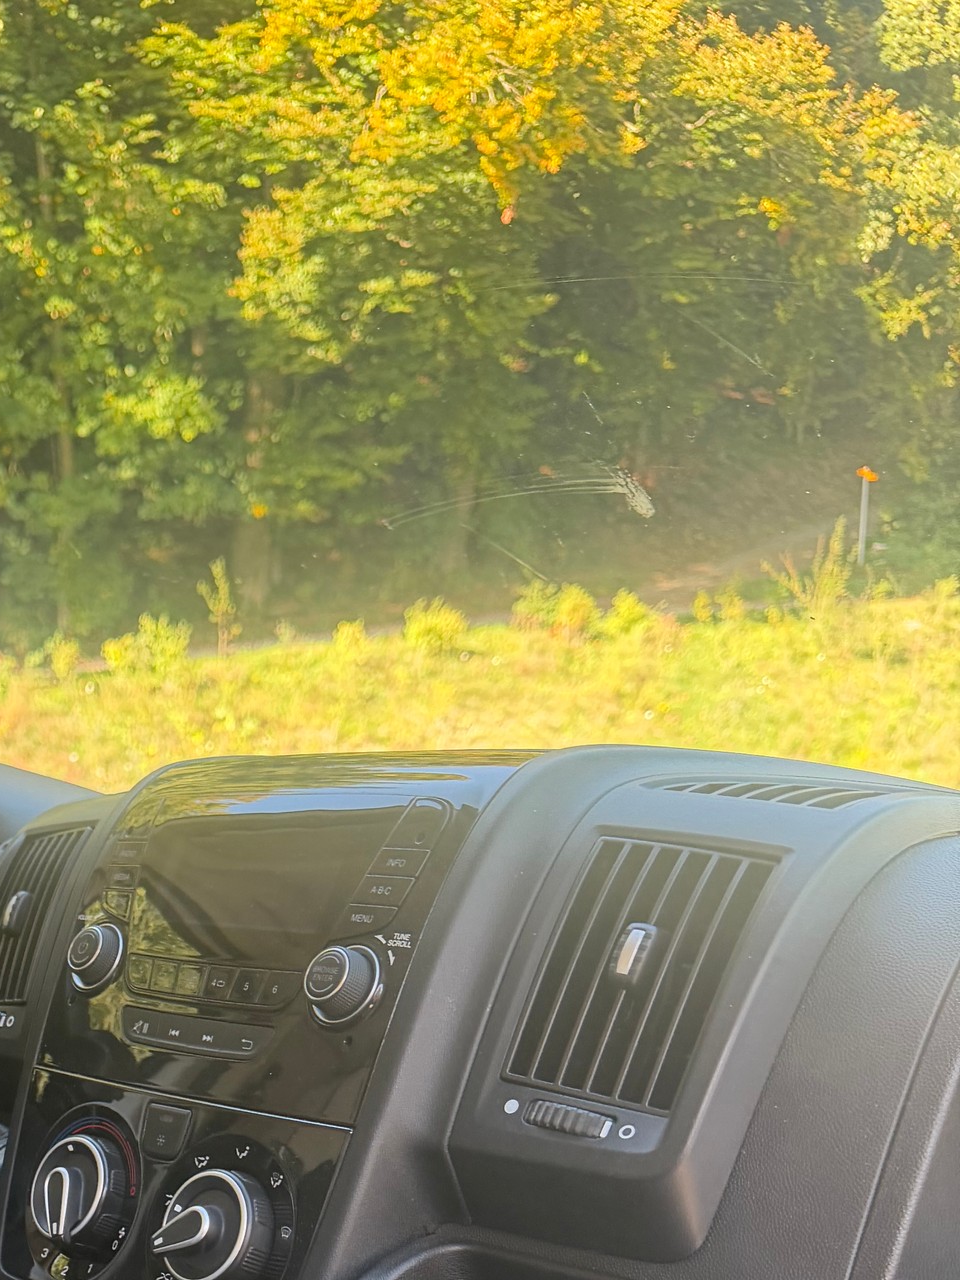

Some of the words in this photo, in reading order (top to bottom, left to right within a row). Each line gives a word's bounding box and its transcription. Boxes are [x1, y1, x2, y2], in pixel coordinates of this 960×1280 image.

[386, 858, 406, 868] INFO
[350, 913, 374, 923] MENU
[393, 932, 411, 941] TUNE
[387, 939, 412, 949] SCROLL
[243, 982, 249, 991] 5
[272, 985, 278, 994] 6
[41, 1248, 49, 1258] 3
[60, 1265, 69, 1276] 2
[87, 1263, 93, 1273] 1
